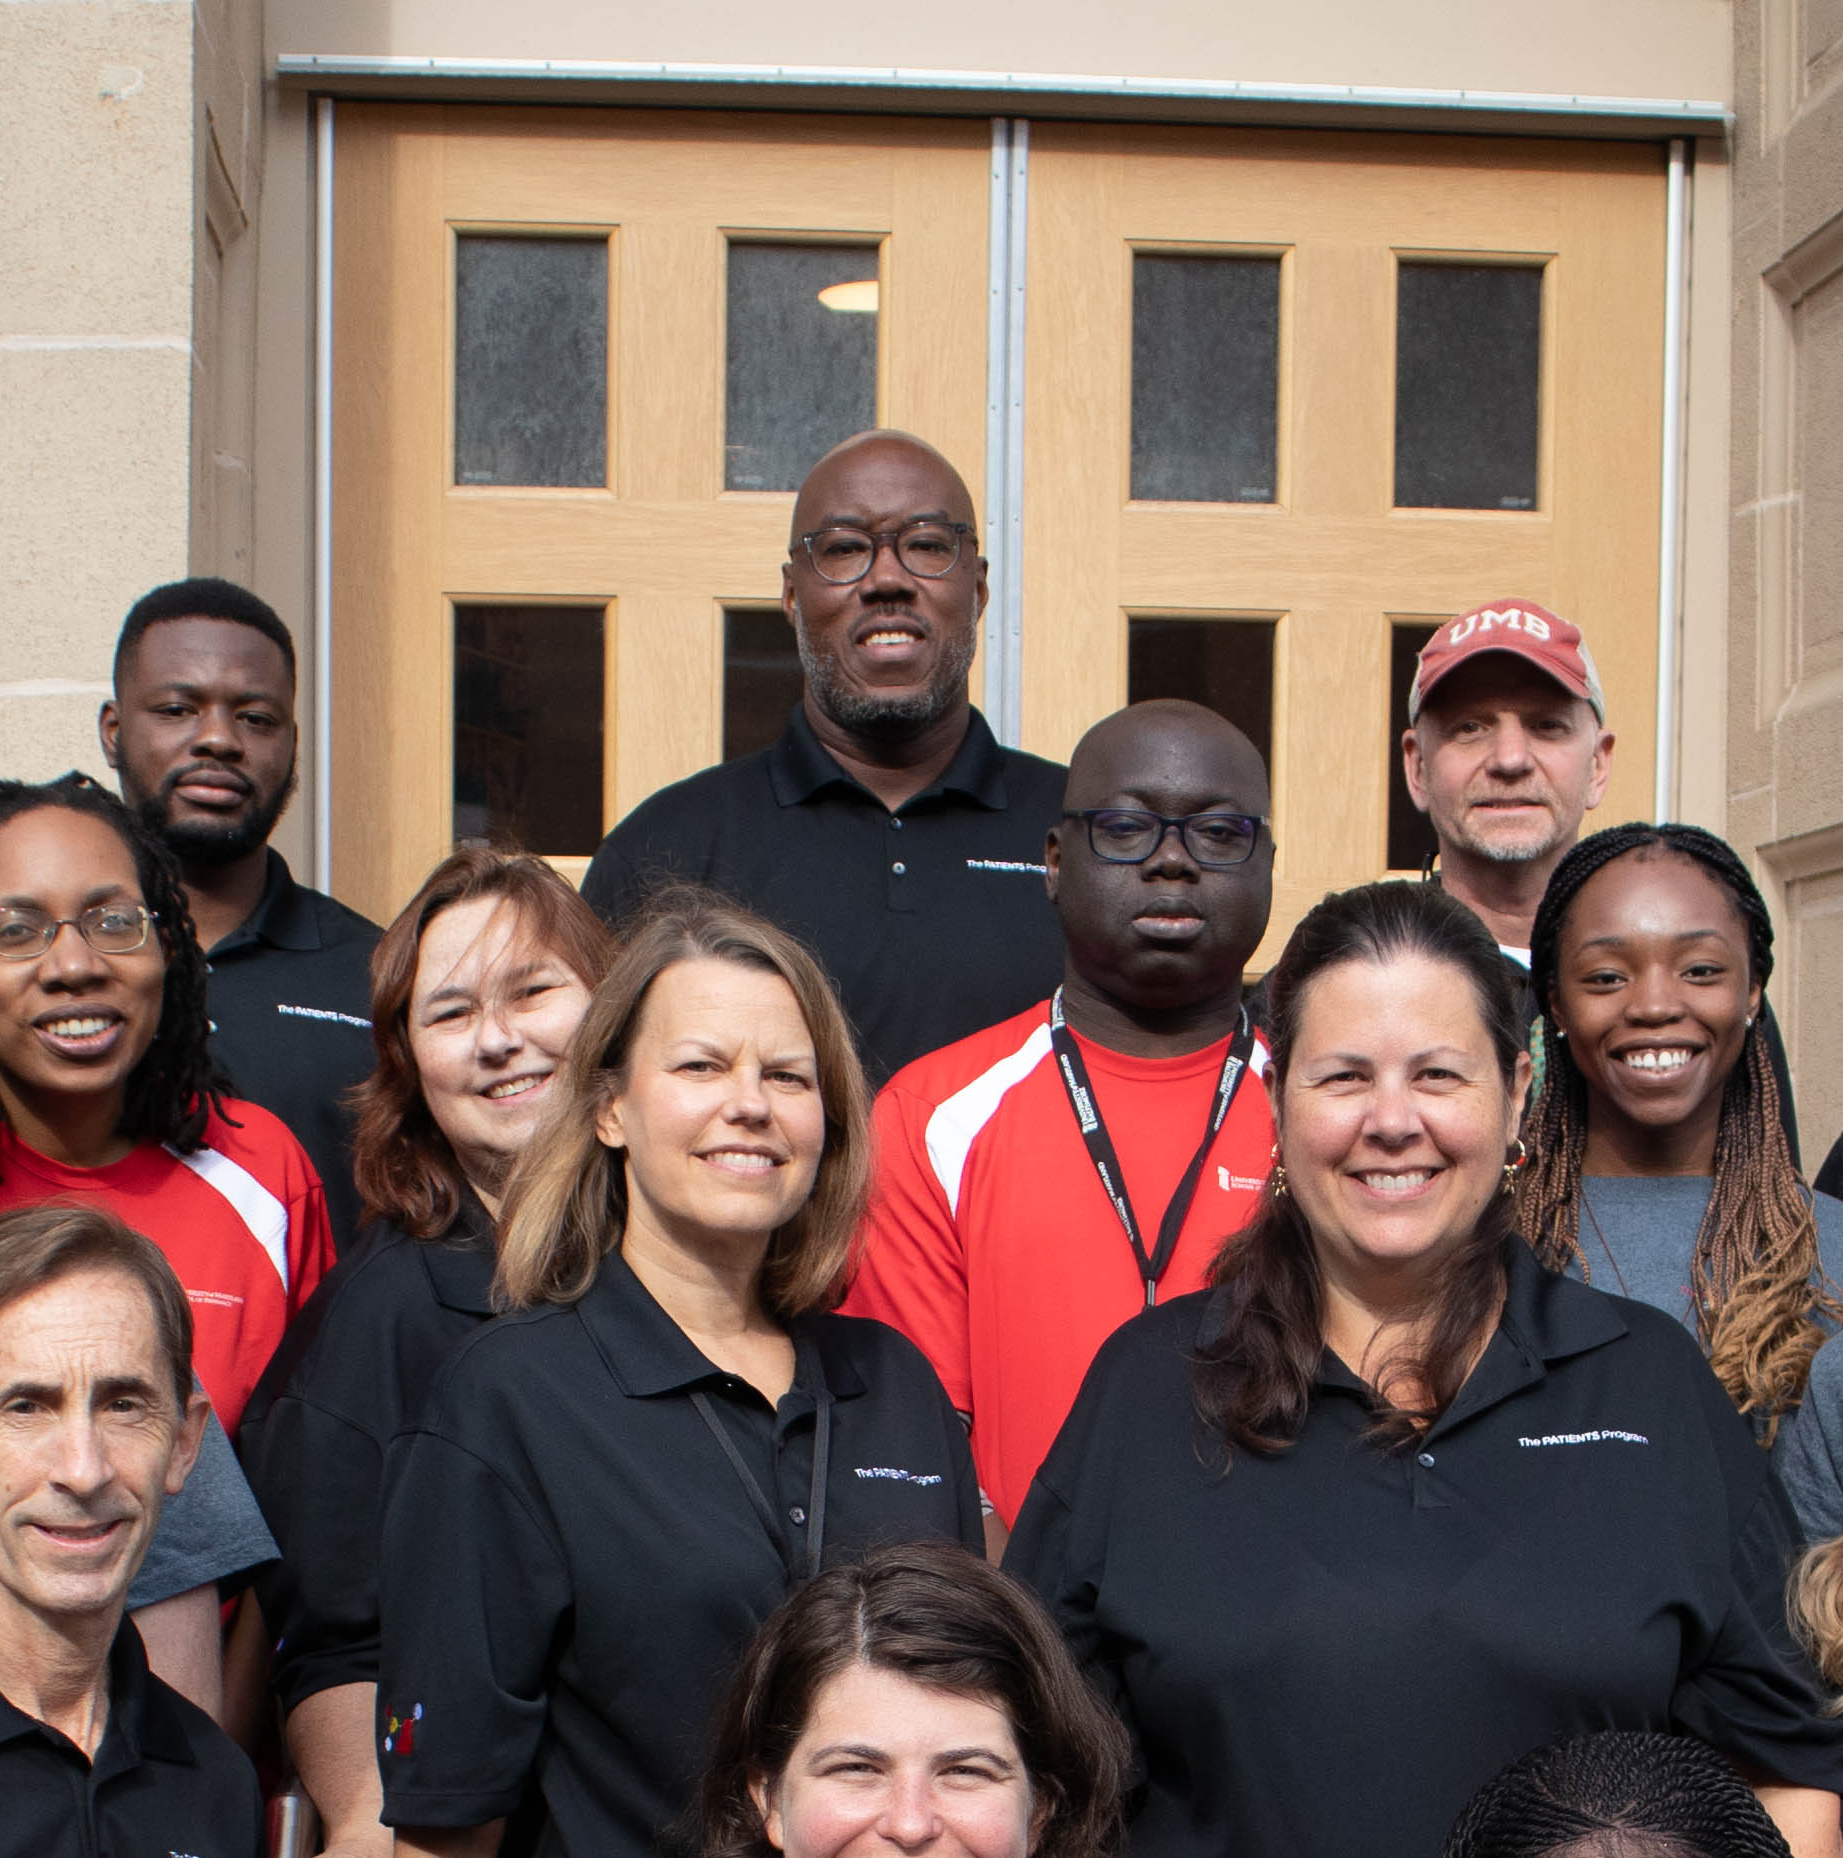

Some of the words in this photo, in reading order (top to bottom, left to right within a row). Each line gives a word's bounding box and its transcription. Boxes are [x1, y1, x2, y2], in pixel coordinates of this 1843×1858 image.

[1449, 608, 1550, 645] UMB
[1518, 1438, 1541, 1447] The
[1542, 1430, 1600, 1446] PATIENTS
[1601, 1429, 1649, 1445] Program
